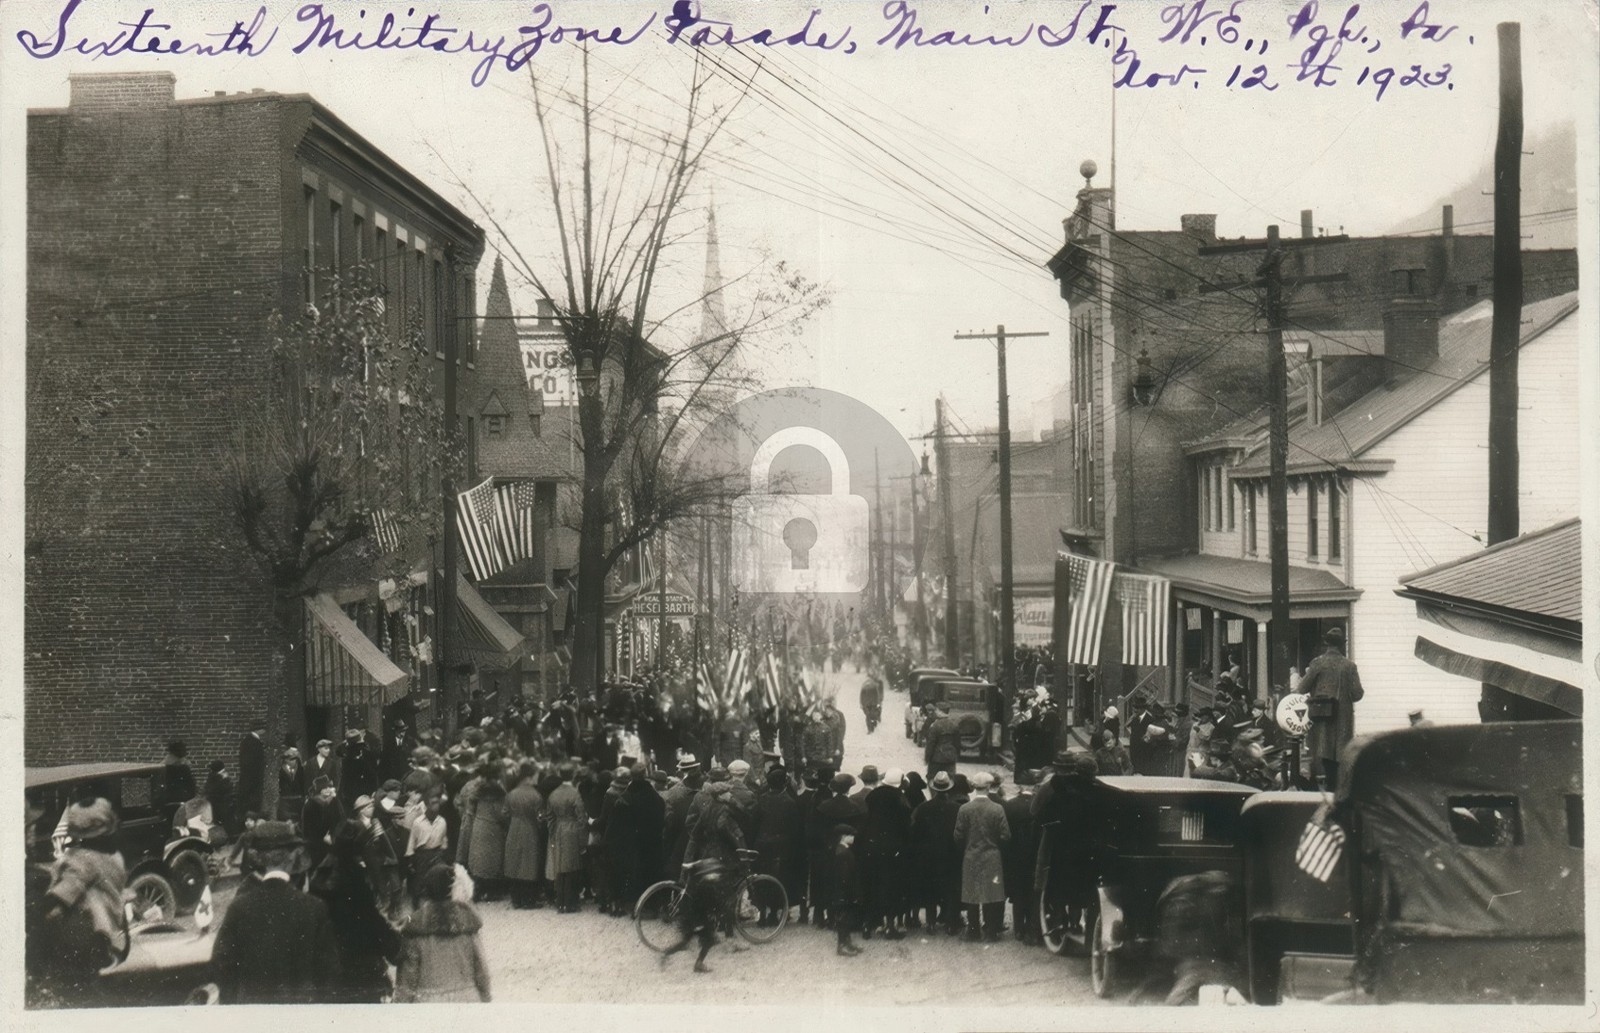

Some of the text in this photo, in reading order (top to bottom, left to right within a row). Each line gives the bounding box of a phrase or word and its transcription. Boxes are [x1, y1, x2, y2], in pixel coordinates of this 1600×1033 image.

[292, 3, 507, 87] Military
[505, 3, 657, 71] Zone
[877, 0, 1034, 48] Main
[1112, 48, 1207, 90] Nov.
[522, 350, 575, 369] NGS
